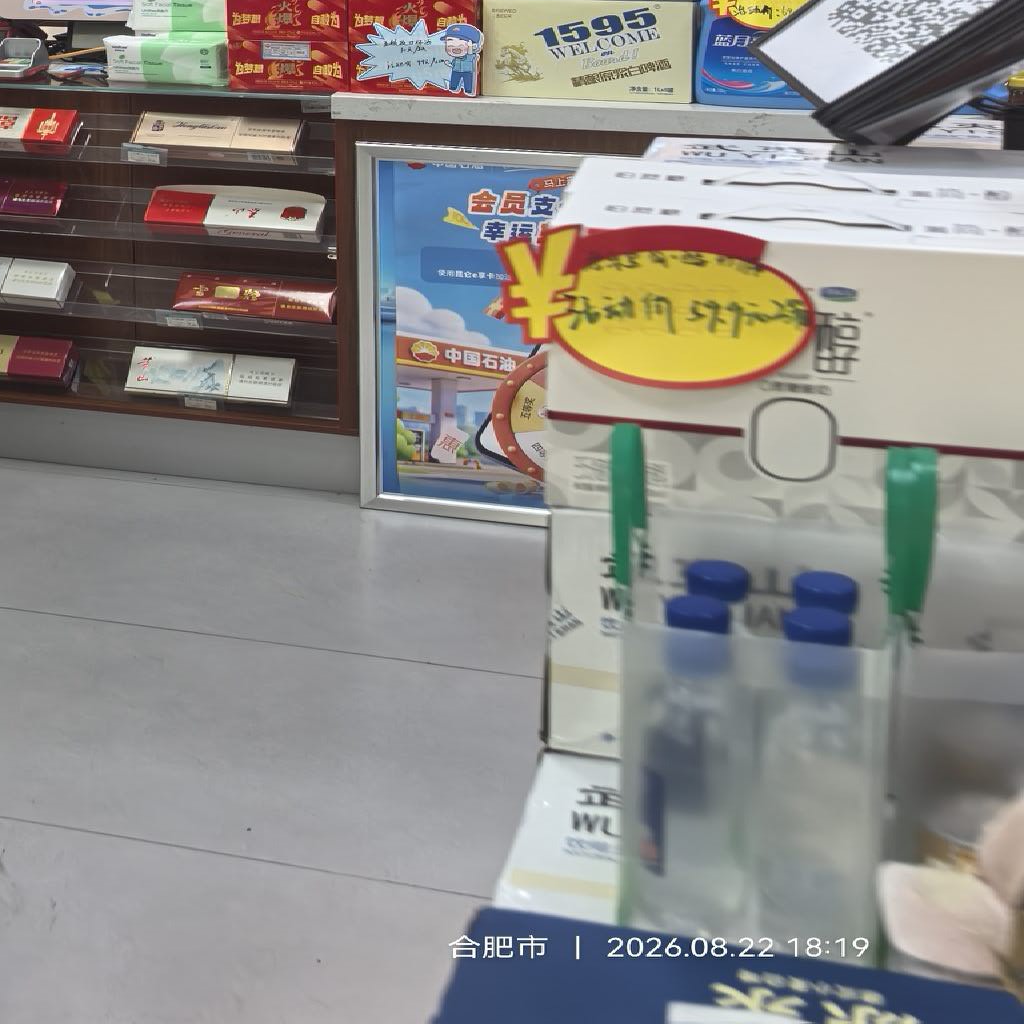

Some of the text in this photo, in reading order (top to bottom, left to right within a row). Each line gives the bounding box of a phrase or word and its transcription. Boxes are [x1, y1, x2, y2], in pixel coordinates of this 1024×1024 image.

[533, 7, 657, 48] 1595
[548, 27, 660, 60] WELCOME
[469, 189, 558, 216] 会员支
[445, 347, 517, 373] 中国石油
[436, 433, 462, 456] 惠
